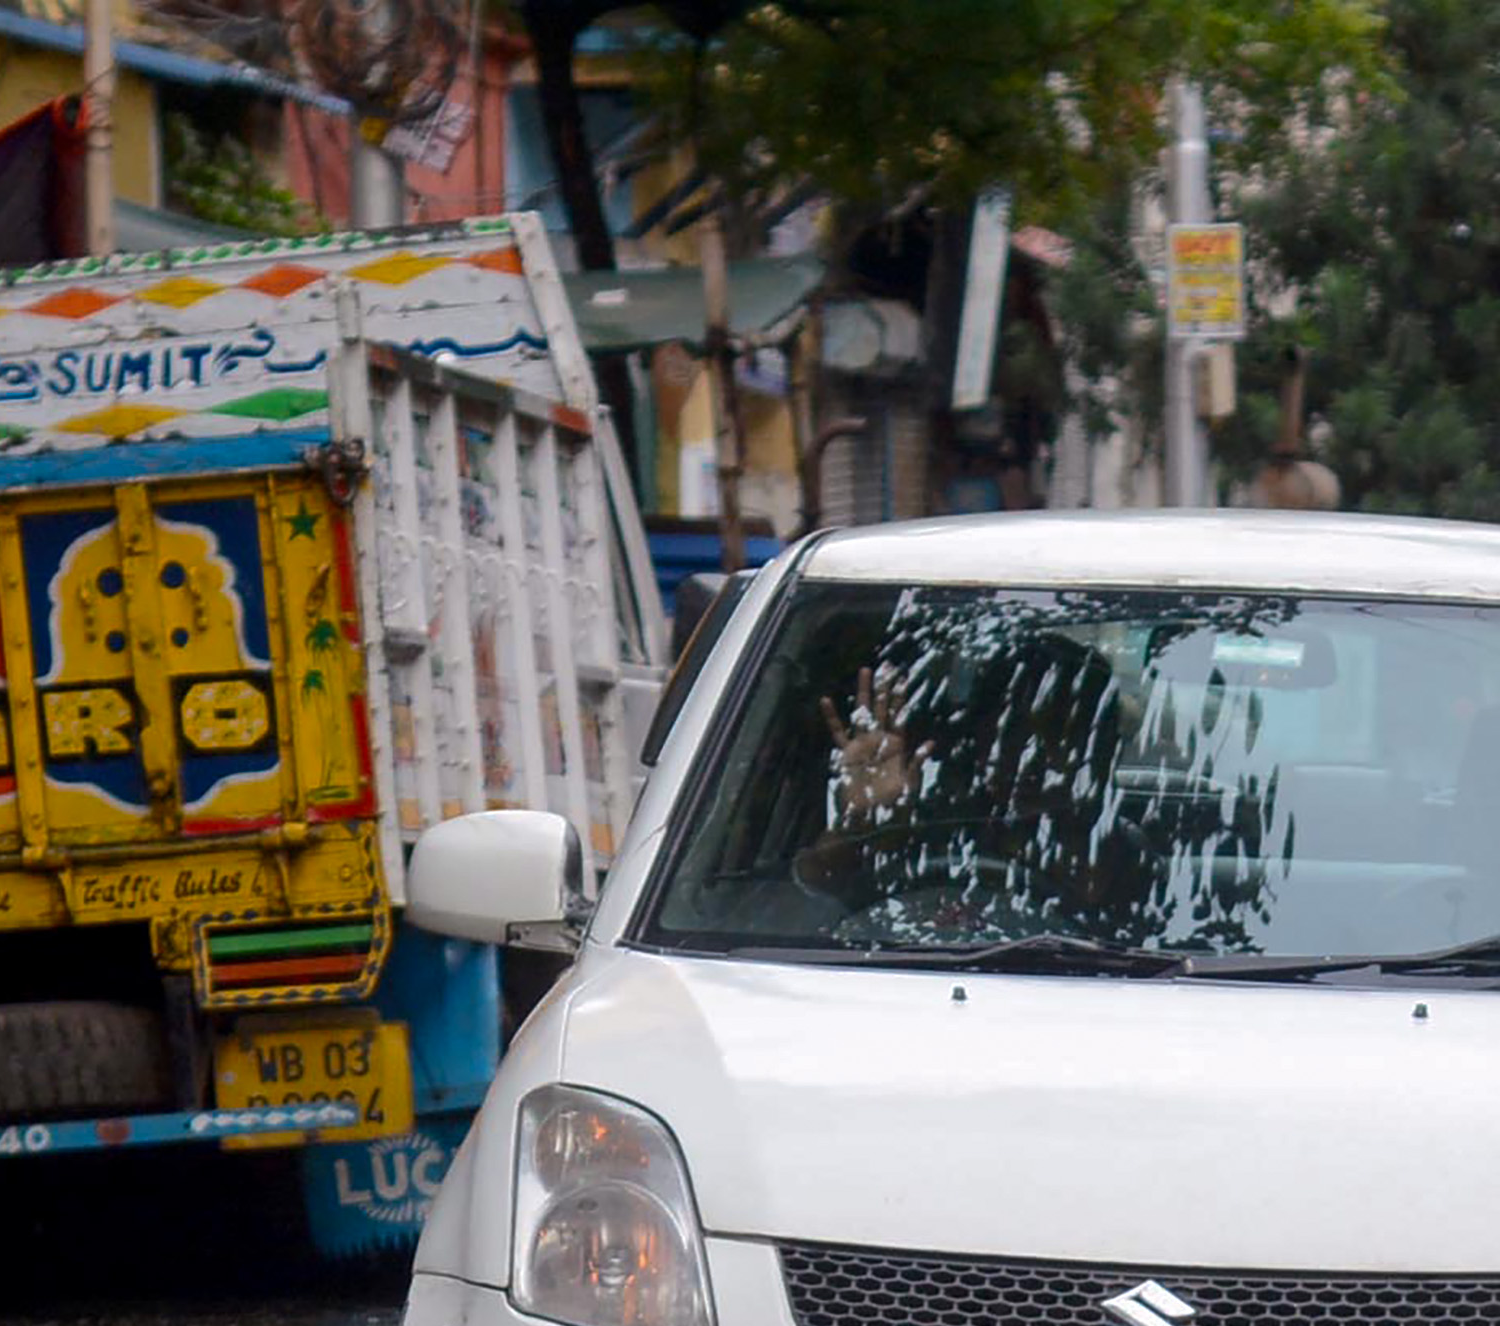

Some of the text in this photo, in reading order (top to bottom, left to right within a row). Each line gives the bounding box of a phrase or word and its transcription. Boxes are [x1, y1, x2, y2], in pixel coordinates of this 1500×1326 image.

[46, 345, 212, 396] SUMIT
[82, 874, 160, 909] Traffic
[256, 1038, 371, 1083] WB 03
